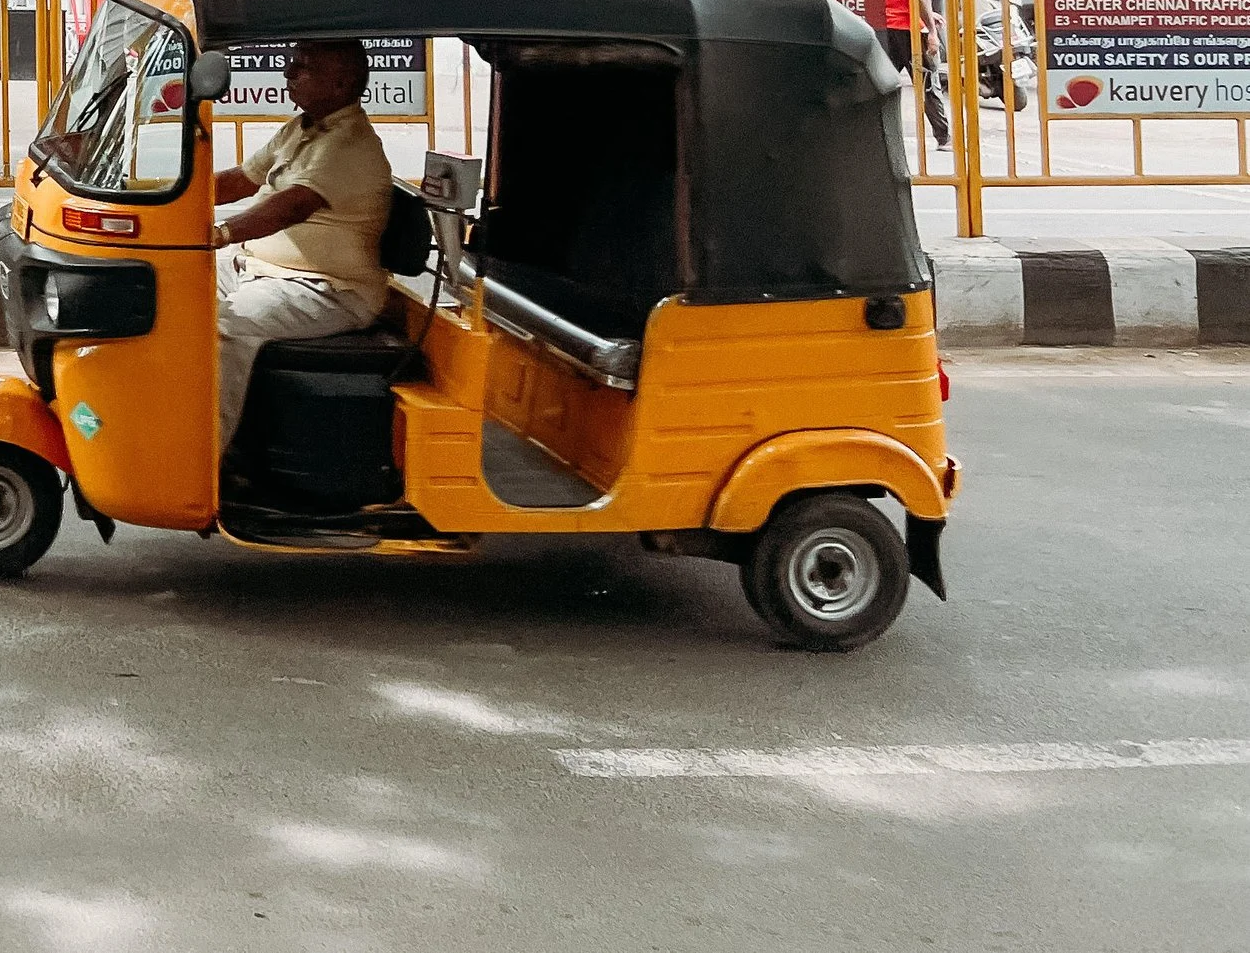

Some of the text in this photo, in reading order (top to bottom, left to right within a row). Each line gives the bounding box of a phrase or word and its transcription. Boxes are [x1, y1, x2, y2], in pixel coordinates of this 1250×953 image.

[1055, 0, 1250, 11] GREATER CHENNAI TRAFFIC
[1055, 16, 1069, 26] E3
[1081, 16, 1153, 26] TEYNAMPET
[1157, 16, 1208, 26] TRAFFIC
[269, 55, 286, 68] IS
[1053, 53, 1100, 66] YOUR
[1104, 53, 1169, 66] SAFETY
[1173, 53, 1190, 66] IS
[1194, 53, 1230, 66] OUR
[1110, 78, 1208, 108] kauvery
